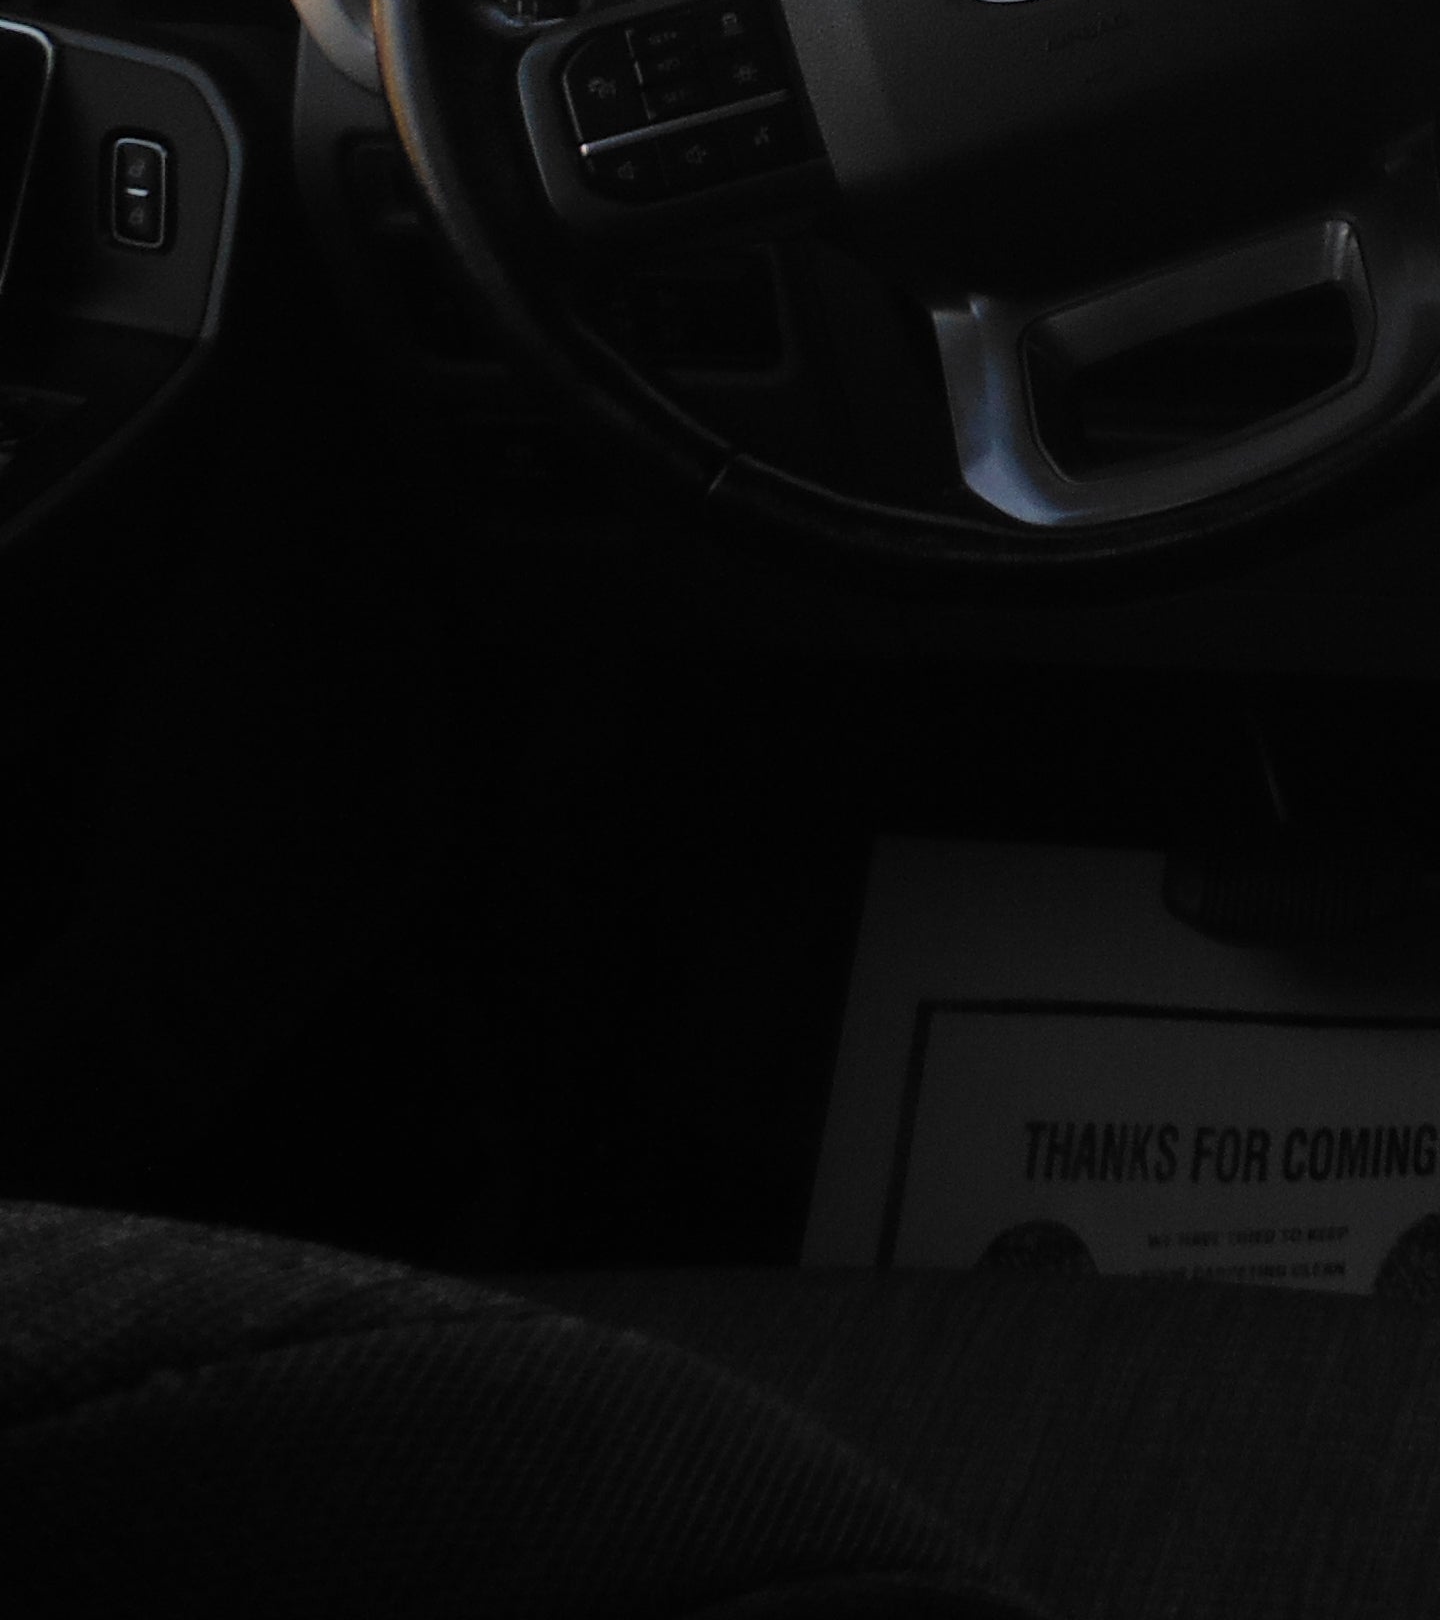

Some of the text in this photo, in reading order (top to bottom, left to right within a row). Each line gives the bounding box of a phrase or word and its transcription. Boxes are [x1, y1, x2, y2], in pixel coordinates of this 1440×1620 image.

[1024, 1121, 1180, 1184] THANKS
[1189, 1124, 1271, 1184] FOR
[1280, 1122, 1440, 1183] COMING
